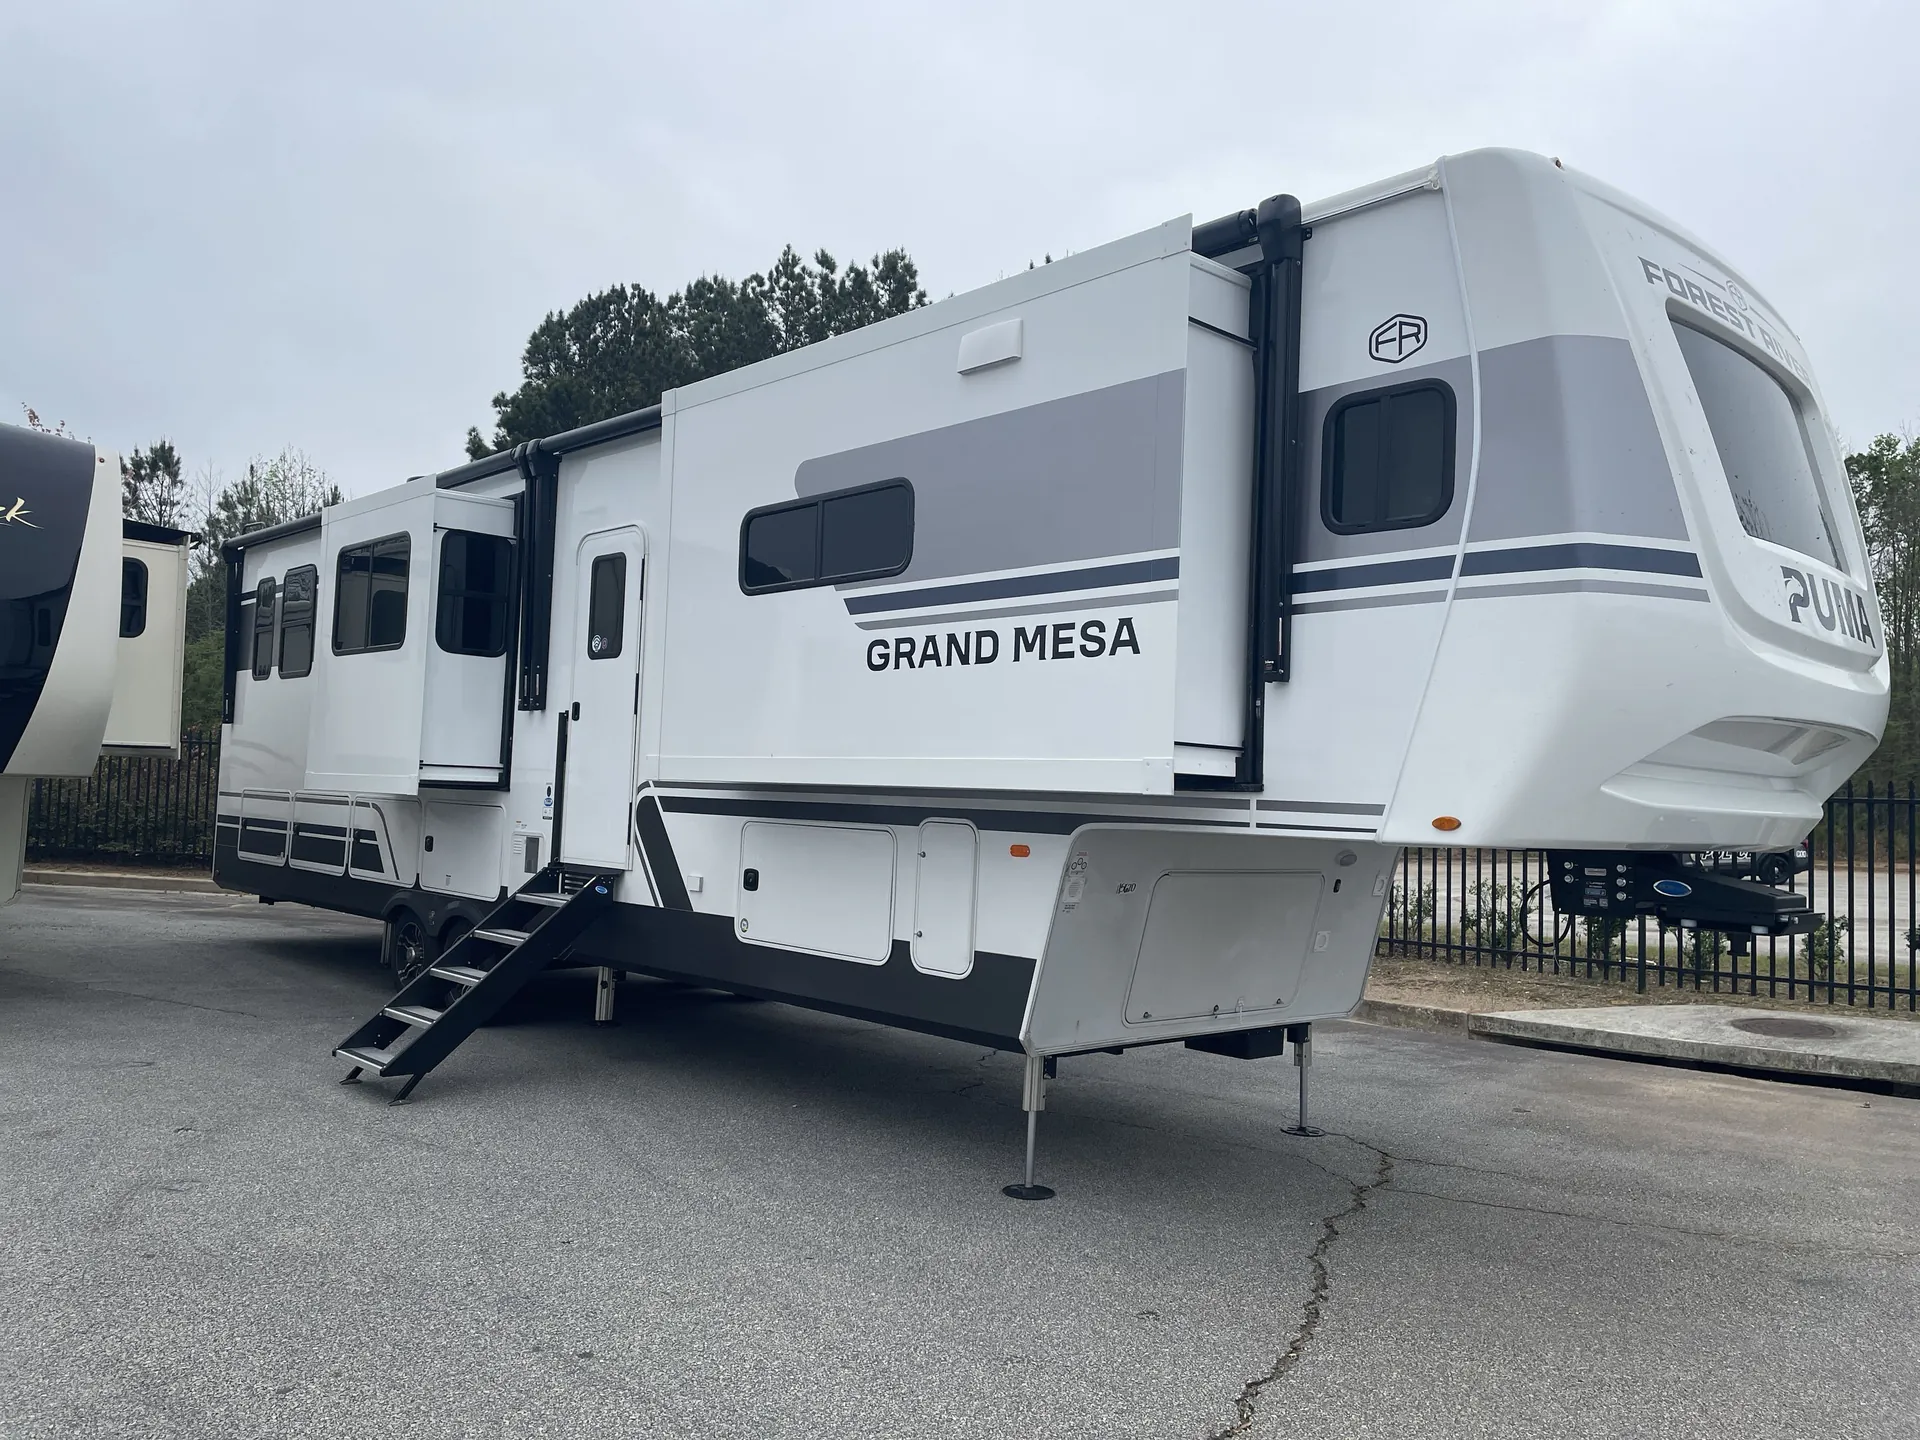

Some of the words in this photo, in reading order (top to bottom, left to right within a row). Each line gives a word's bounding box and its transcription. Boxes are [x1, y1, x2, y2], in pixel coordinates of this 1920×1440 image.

[1637, 255, 1756, 339] FOREST
[1756, 323, 1812, 388] RIVER
[1780, 565, 1876, 649] PUMA
[866, 629, 999, 671] GRAND
[1013, 616, 1141, 662] MESA
[1700, 850, 1753, 860] PLC
